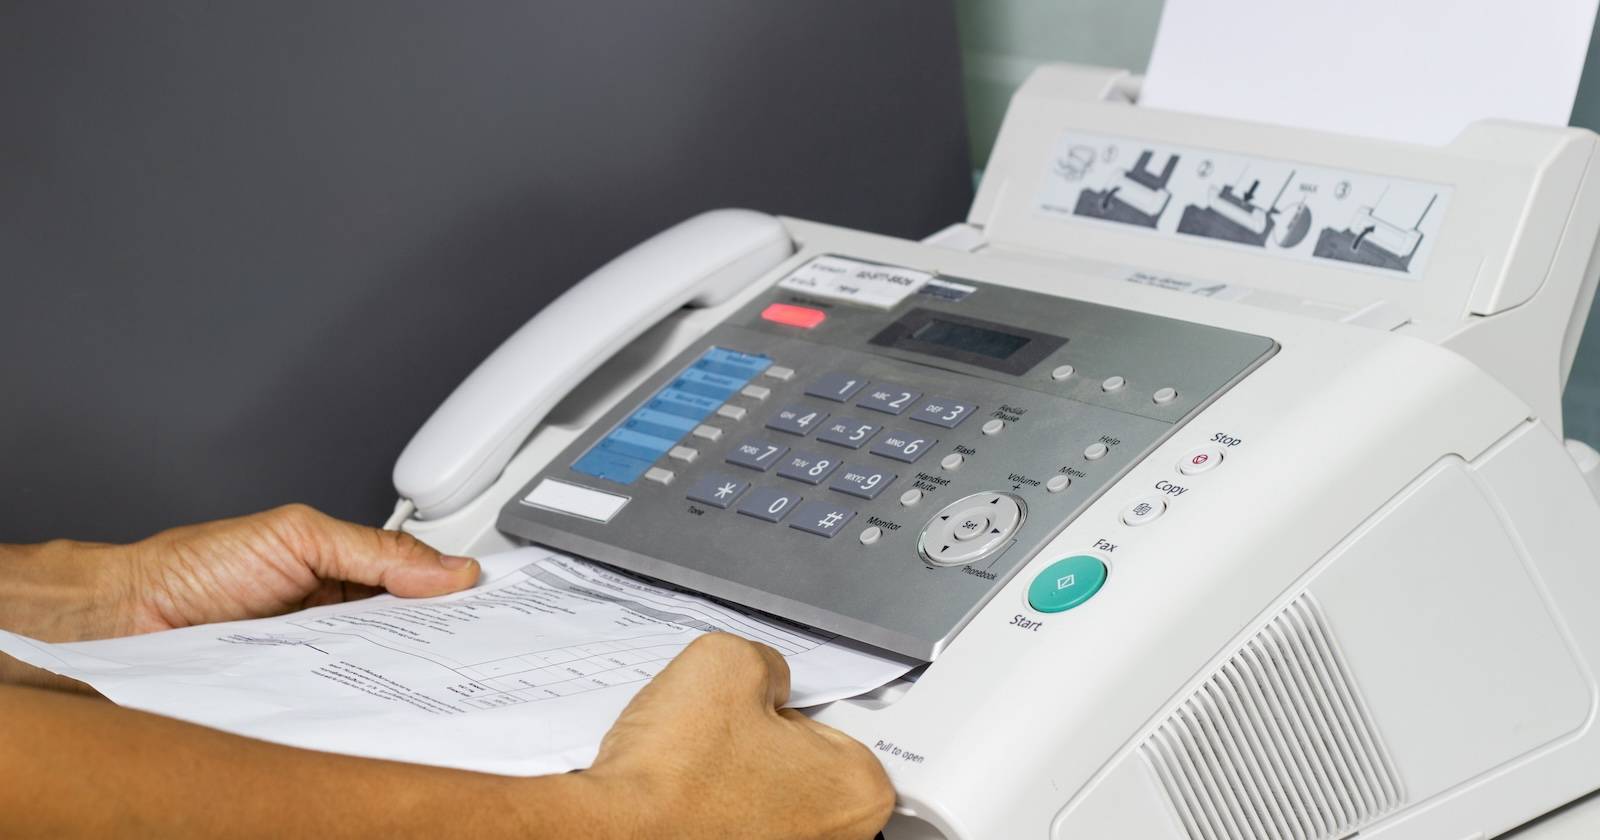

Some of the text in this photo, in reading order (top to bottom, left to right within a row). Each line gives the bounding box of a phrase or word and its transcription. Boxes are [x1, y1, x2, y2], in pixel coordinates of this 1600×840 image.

[839, 380, 857, 394] 1
[873, 392, 911, 408] ABC 2
[925, 404, 964, 420] DEF 3
[998, 404, 1025, 415] Redial
[797, 412, 817, 427] 4
[832, 424, 872, 440] JKL 5
[1210, 432, 1242, 447] Stop
[886, 438, 924, 454] MNO 6
[1099, 435, 1121, 446] Help
[757, 446, 778, 461] 7
[954, 445, 976, 456] Flash
[791, 458, 830, 476] TUV 8
[1059, 465, 1086, 479] Menu
[845, 472, 882, 490] WXYZ 9
[913, 480, 937, 492] Mute
[915, 472, 951, 487] Handset
[1008, 472, 1041, 487] Volume
[1154, 480, 1190, 497] Copy
[768, 497, 788, 514] 0
[818, 511, 843, 529] #
[866, 516, 902, 531] Monitor
[962, 520, 977, 530] Set
[1092, 538, 1118, 553] Fax
[961, 565, 997, 581] Phonebook
[1009, 614, 1043, 632] Start
[875, 739, 925, 763] Pull to open
